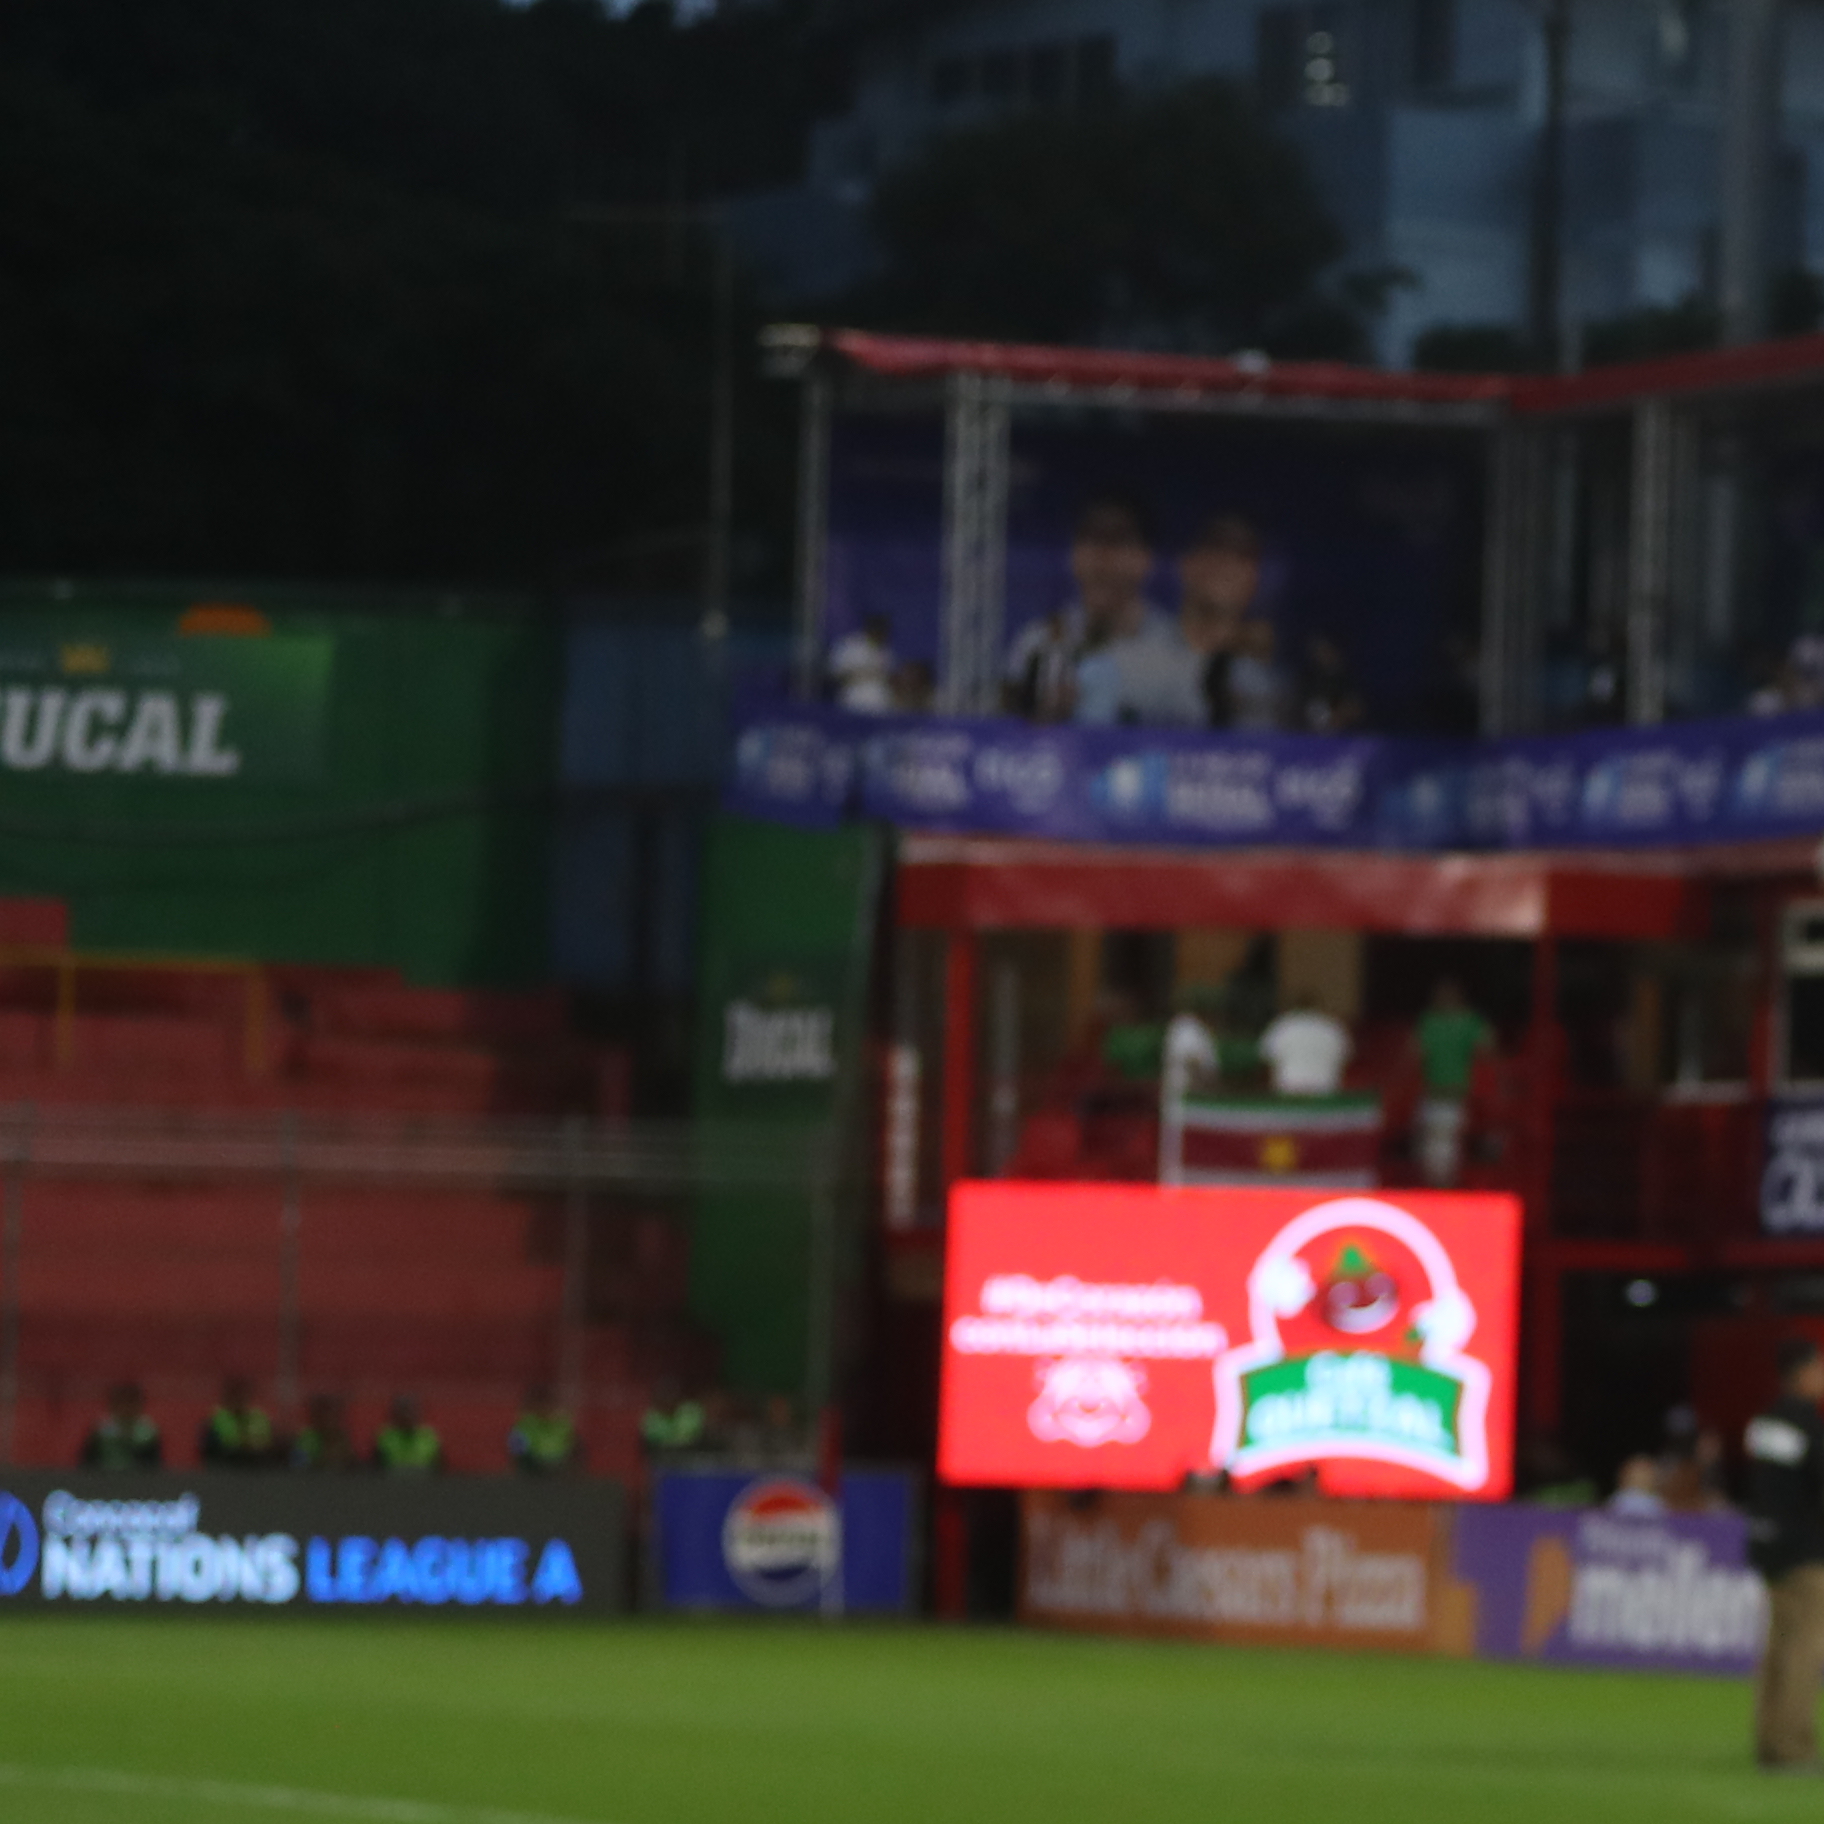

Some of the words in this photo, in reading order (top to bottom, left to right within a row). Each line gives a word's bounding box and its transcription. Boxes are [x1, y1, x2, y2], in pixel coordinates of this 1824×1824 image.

[0, 684, 241, 777] UCAL
[42, 1531, 300, 1604] NATIONS
[306, 1535, 530, 1605] LEAGUE
[532, 1537, 583, 1605] A
